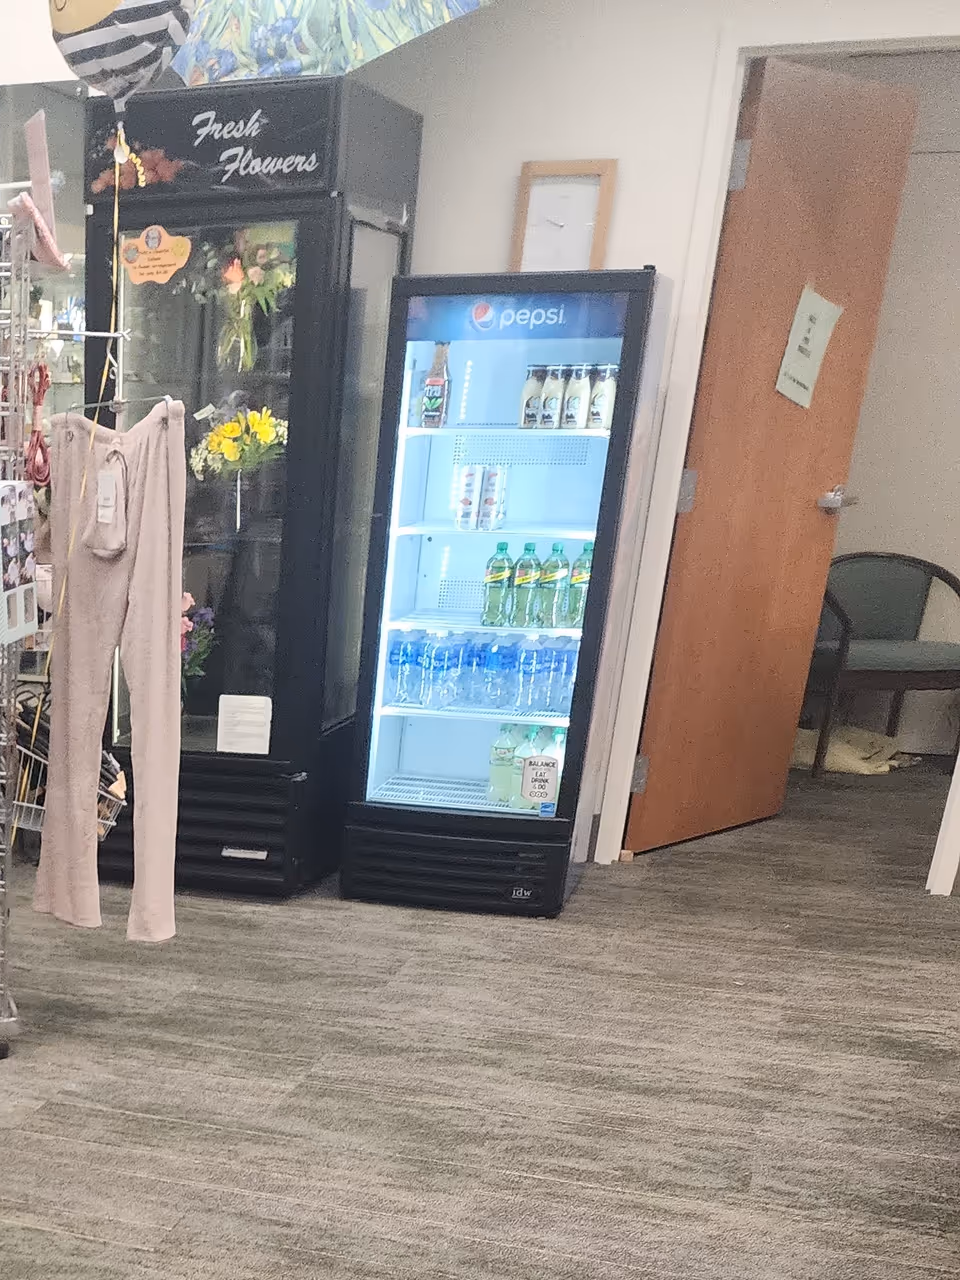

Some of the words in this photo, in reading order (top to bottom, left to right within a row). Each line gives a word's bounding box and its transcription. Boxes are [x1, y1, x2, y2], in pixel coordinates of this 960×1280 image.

[191, 108, 263, 147] Fresh
[219, 146, 319, 183] Flowers
[499, 303, 565, 330] pepsi
[528, 760, 556, 768] BALANCE
